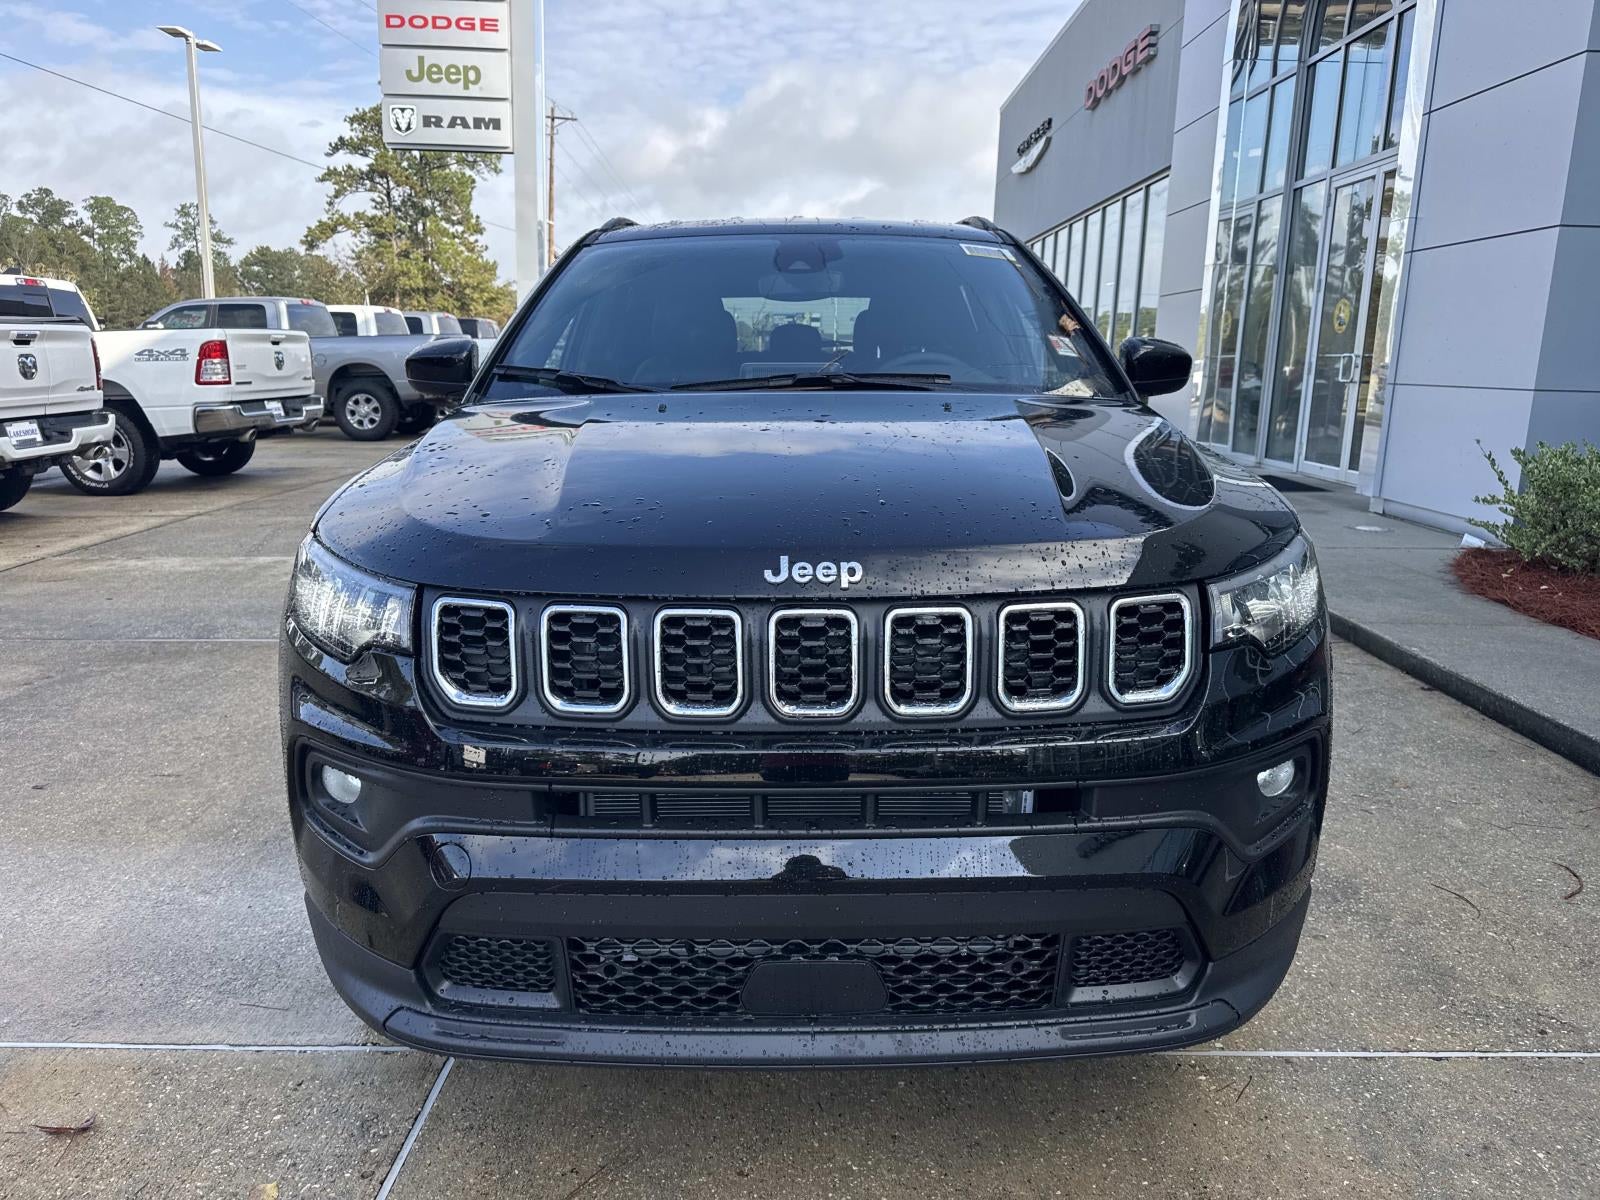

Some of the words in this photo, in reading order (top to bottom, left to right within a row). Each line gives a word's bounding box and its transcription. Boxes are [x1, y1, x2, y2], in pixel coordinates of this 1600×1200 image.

[385, 14, 499, 33] DODGE
[405, 55, 482, 91] Jeep
[1084, 24, 1160, 111] DODGE
[422, 114, 502, 131] RAM
[763, 555, 863, 589] Jeep
